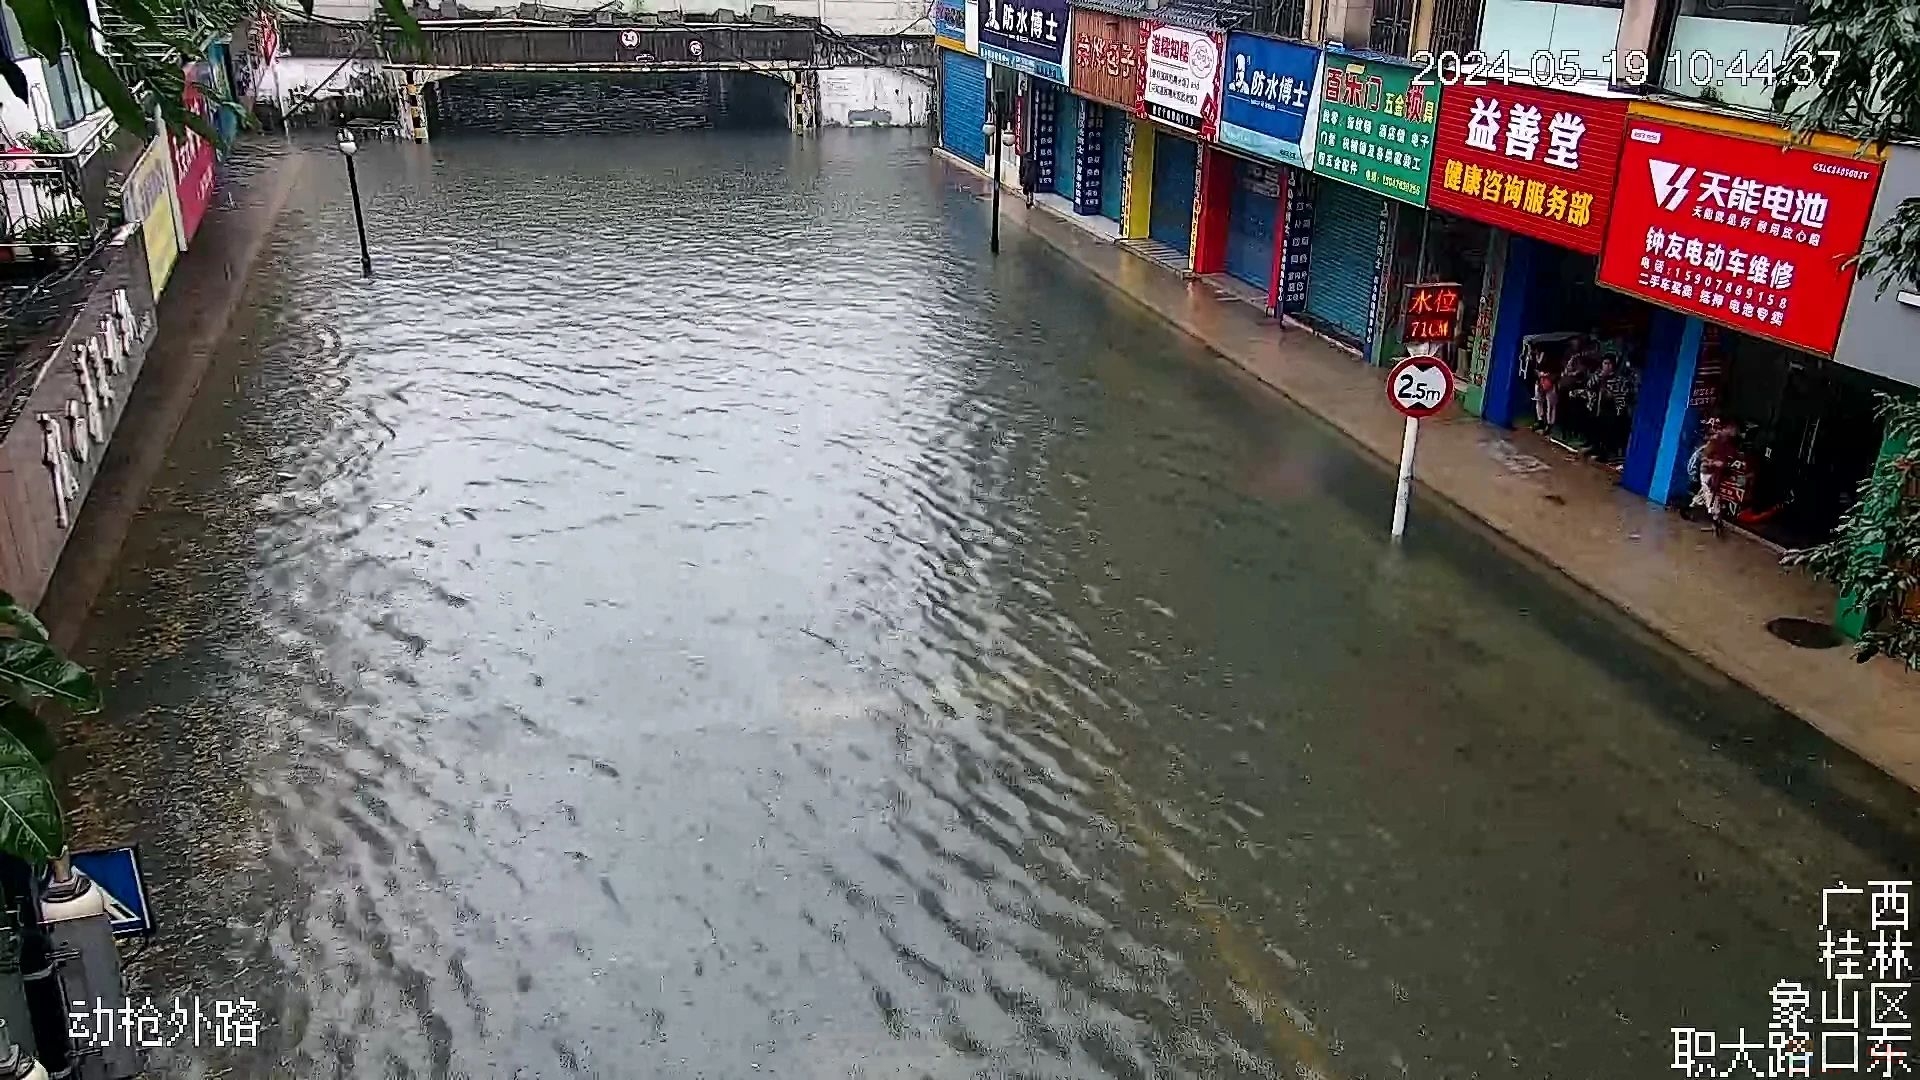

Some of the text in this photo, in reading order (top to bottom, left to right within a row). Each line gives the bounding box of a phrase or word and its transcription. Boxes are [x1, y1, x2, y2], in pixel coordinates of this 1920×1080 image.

[1002, 3, 1058, 42] 防水博士
[1251, 71, 1308, 108] 防水博士
[1411, 133, 1431, 151] 电子
[1465, 97, 1587, 170] 益善堂
[1443, 158, 1594, 227] 健康咨询服务部
[1698, 171, 1829, 229] 天能电池
[1645, 226, 1795, 291] 钟友电动车维修
[1409, 289, 1457, 314] 水位
[1638, 273, 1694, 300] 二手车买卖
[1729, 300, 1785, 328] 电池专卖
[1411, 320, 1449, 338] 71CM
[1396, 373, 1441, 401] 2.5m
